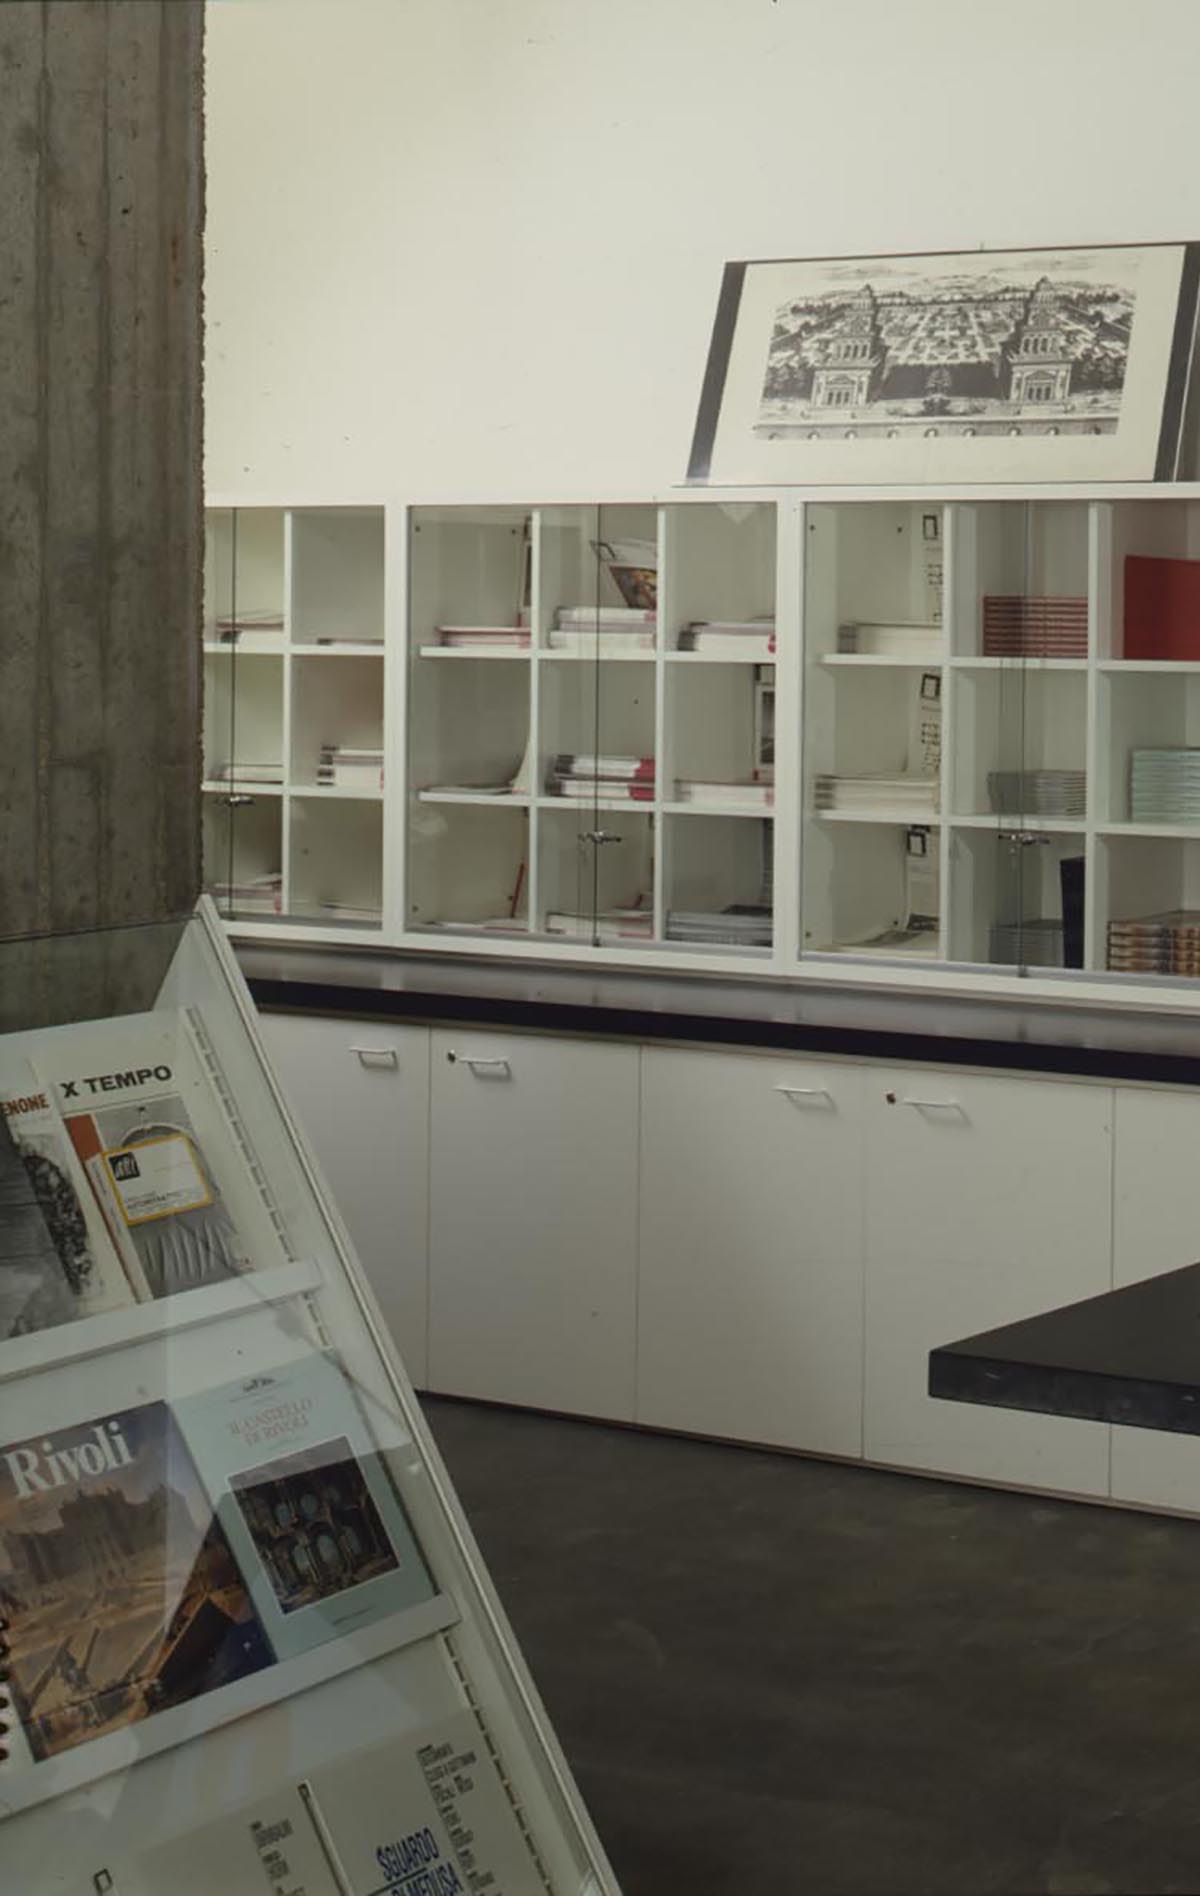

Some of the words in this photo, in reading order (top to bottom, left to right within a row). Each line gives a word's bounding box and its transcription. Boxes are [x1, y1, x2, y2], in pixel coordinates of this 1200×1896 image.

[60, 1081, 79, 1099] X
[83, 1065, 172, 1094] TEMPO
[3, 1421, 134, 1498] Rivoli
[376, 1826, 438, 1882] SGUARDO
